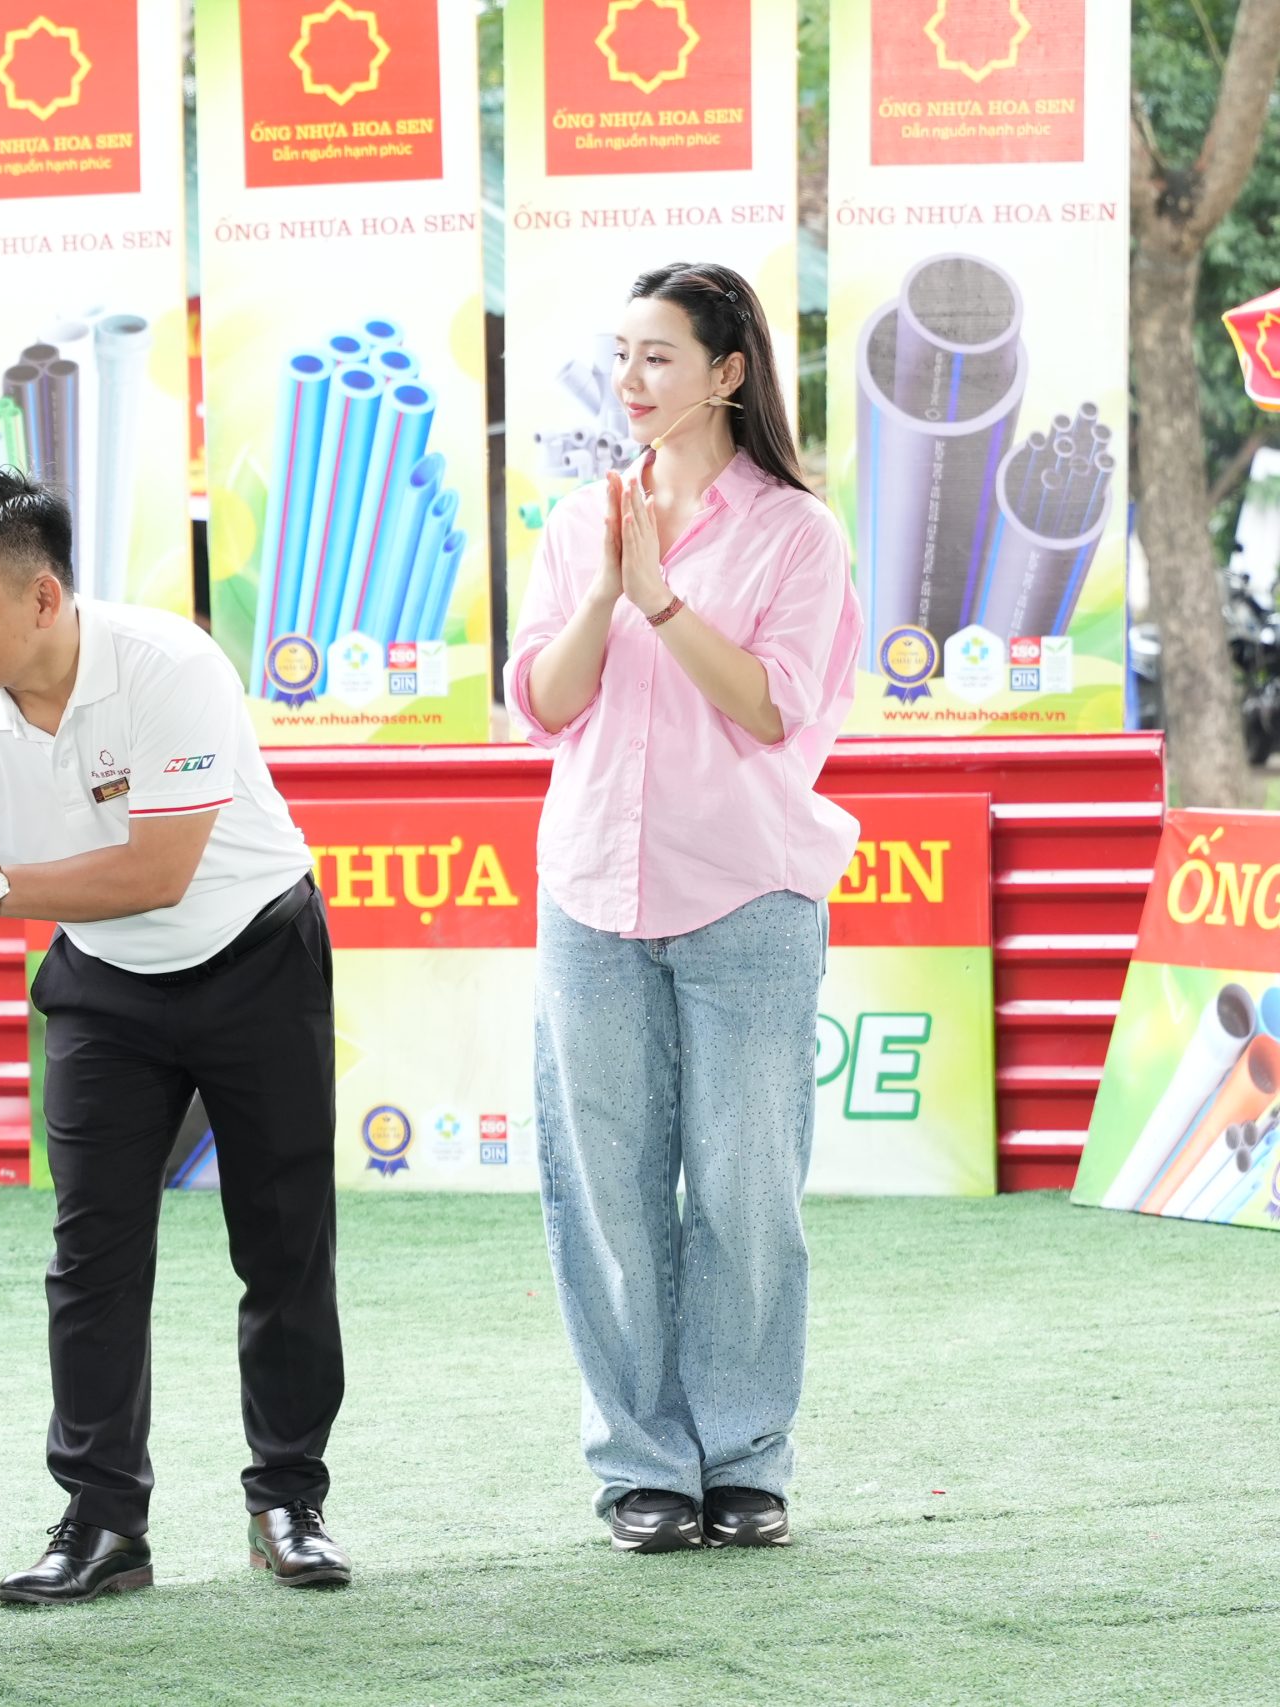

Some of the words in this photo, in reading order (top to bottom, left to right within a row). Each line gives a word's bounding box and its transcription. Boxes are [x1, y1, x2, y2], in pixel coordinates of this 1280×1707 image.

[552, 107, 595, 129] ỐNG
[599, 111, 654, 130] NHỰA
[658, 110, 701, 126] HOA
[704, 107, 744, 123] SEN
[879, 96, 921, 118] ỐNG
[927, 99, 983, 120] NHỰA
[988, 99, 1030, 115] HOA
[1035, 98, 1076, 114] SEN
[250, 120, 292, 143] ỐNG
[295, 122, 348, 142] NHỰA
[352, 121, 392, 137] HOA
[395, 118, 434, 135] SEN
[0, 137, 50, 158] NHỰA
[53, 136, 92, 153] HOA
[95, 133, 133, 150] SEN
[513, 200, 572, 230] ỐNG
[581, 207, 657, 232] NHỰA
[665, 206, 722, 225] HOA
[731, 204, 786, 223] SEN
[836, 197, 896, 226] ỐNG
[906, 203, 984, 229] NHỰA
[993, 204, 1052, 223] HOA
[1061, 203, 1117, 222] SEN
[214, 215, 271, 243] ỐNG
[279, 217, 353, 243] NHỰA
[360, 216, 416, 236] HOA
[424, 213, 477, 233] SEN
[62, 233, 115, 252] HOA
[121, 230, 173, 250] SEN
[272, 712, 443, 728] www.nhuahoasen.vn
[883, 709, 1065, 723] www.nhuahoasen.vn
[163, 754, 216, 773] HTV
[480, 1120, 506, 1134] ISO
[482, 1148, 506, 1161] DIN
